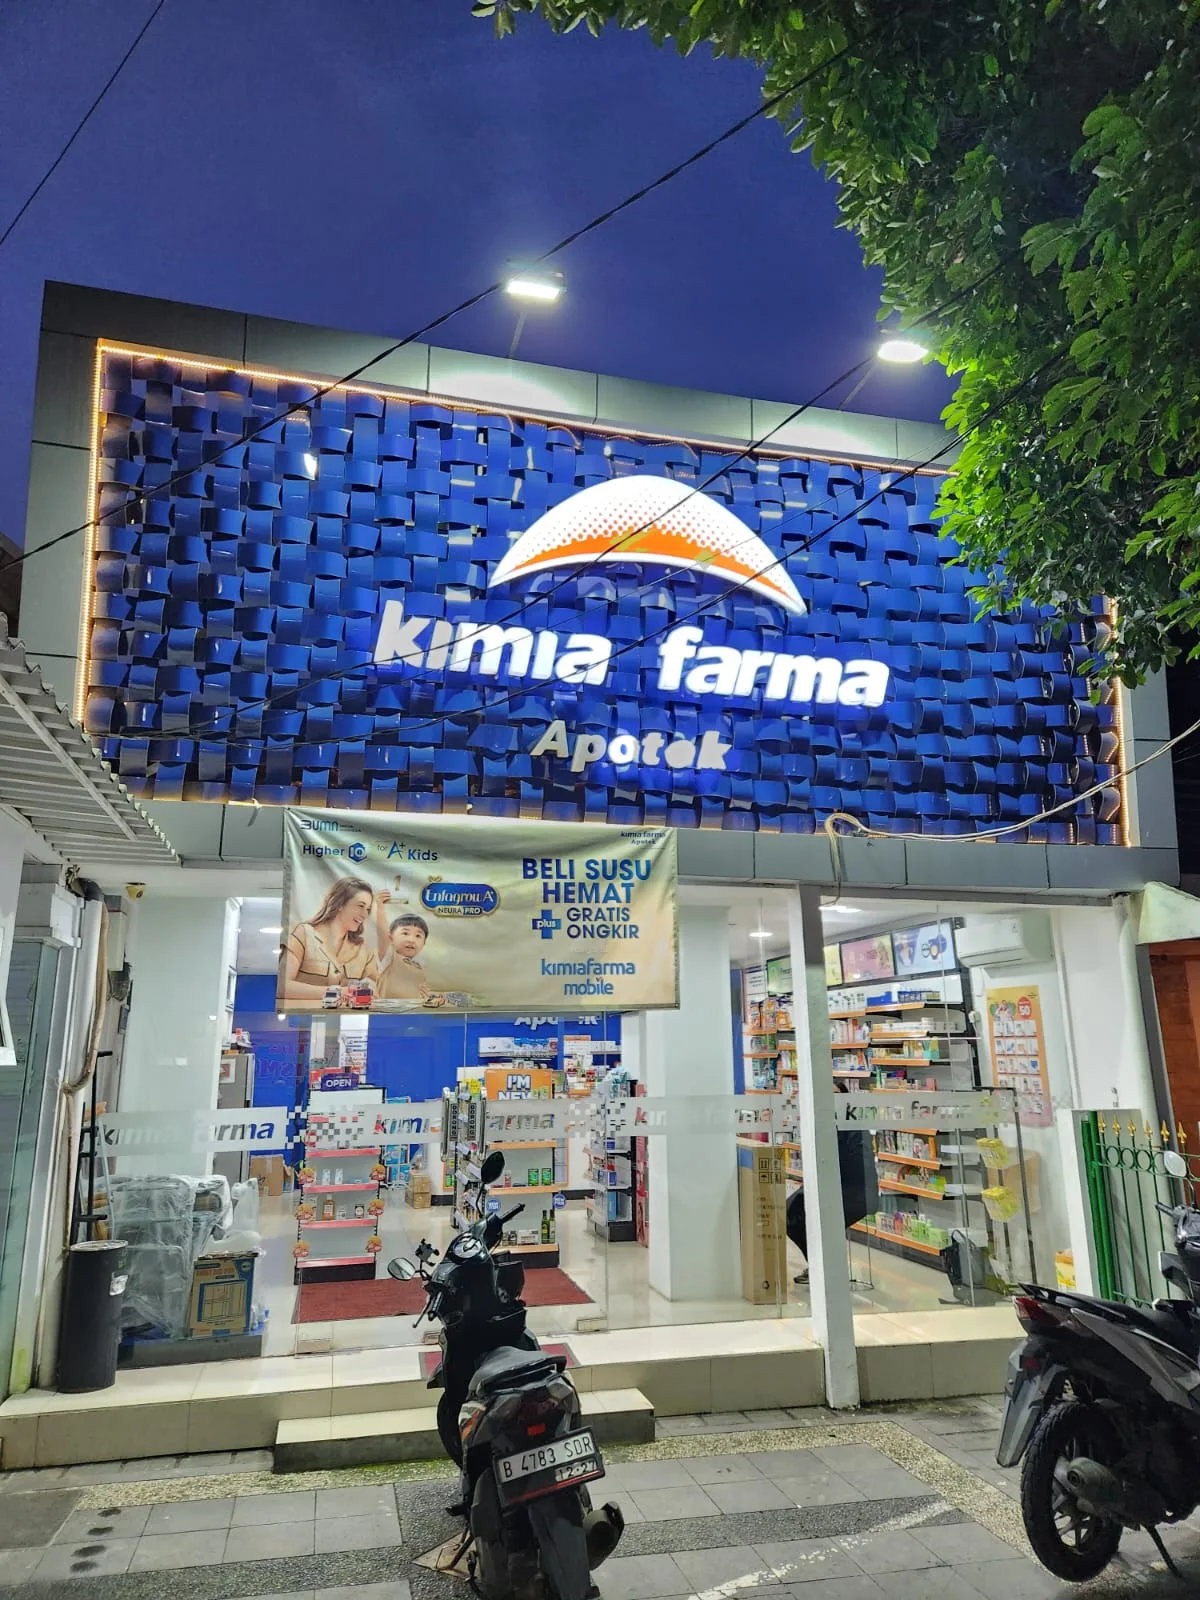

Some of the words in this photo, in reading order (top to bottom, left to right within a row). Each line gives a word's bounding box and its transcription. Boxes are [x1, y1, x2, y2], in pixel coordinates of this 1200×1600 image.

[374, 600, 612, 685] kimia
[657, 625, 890, 707] farma
[531, 720, 732, 773] Apotek
[303, 844, 345, 857] Higher
[408, 849, 438, 861] Kids
[522, 858, 575, 880] BELI
[585, 858, 651, 881] SUSU
[542, 882, 635, 904] HEMAT
[566, 907, 631, 922] GRATIS
[536, 919, 557, 929] plus
[566, 924, 640, 939] ONGKIR
[541, 958, 636, 975] kimiafarma
[564, 978, 614, 995] mobile
[325, 1079, 352, 1088] OPEN
[503, 1461, 513, 1478] B
[521, 1448, 556, 1471] 4783
